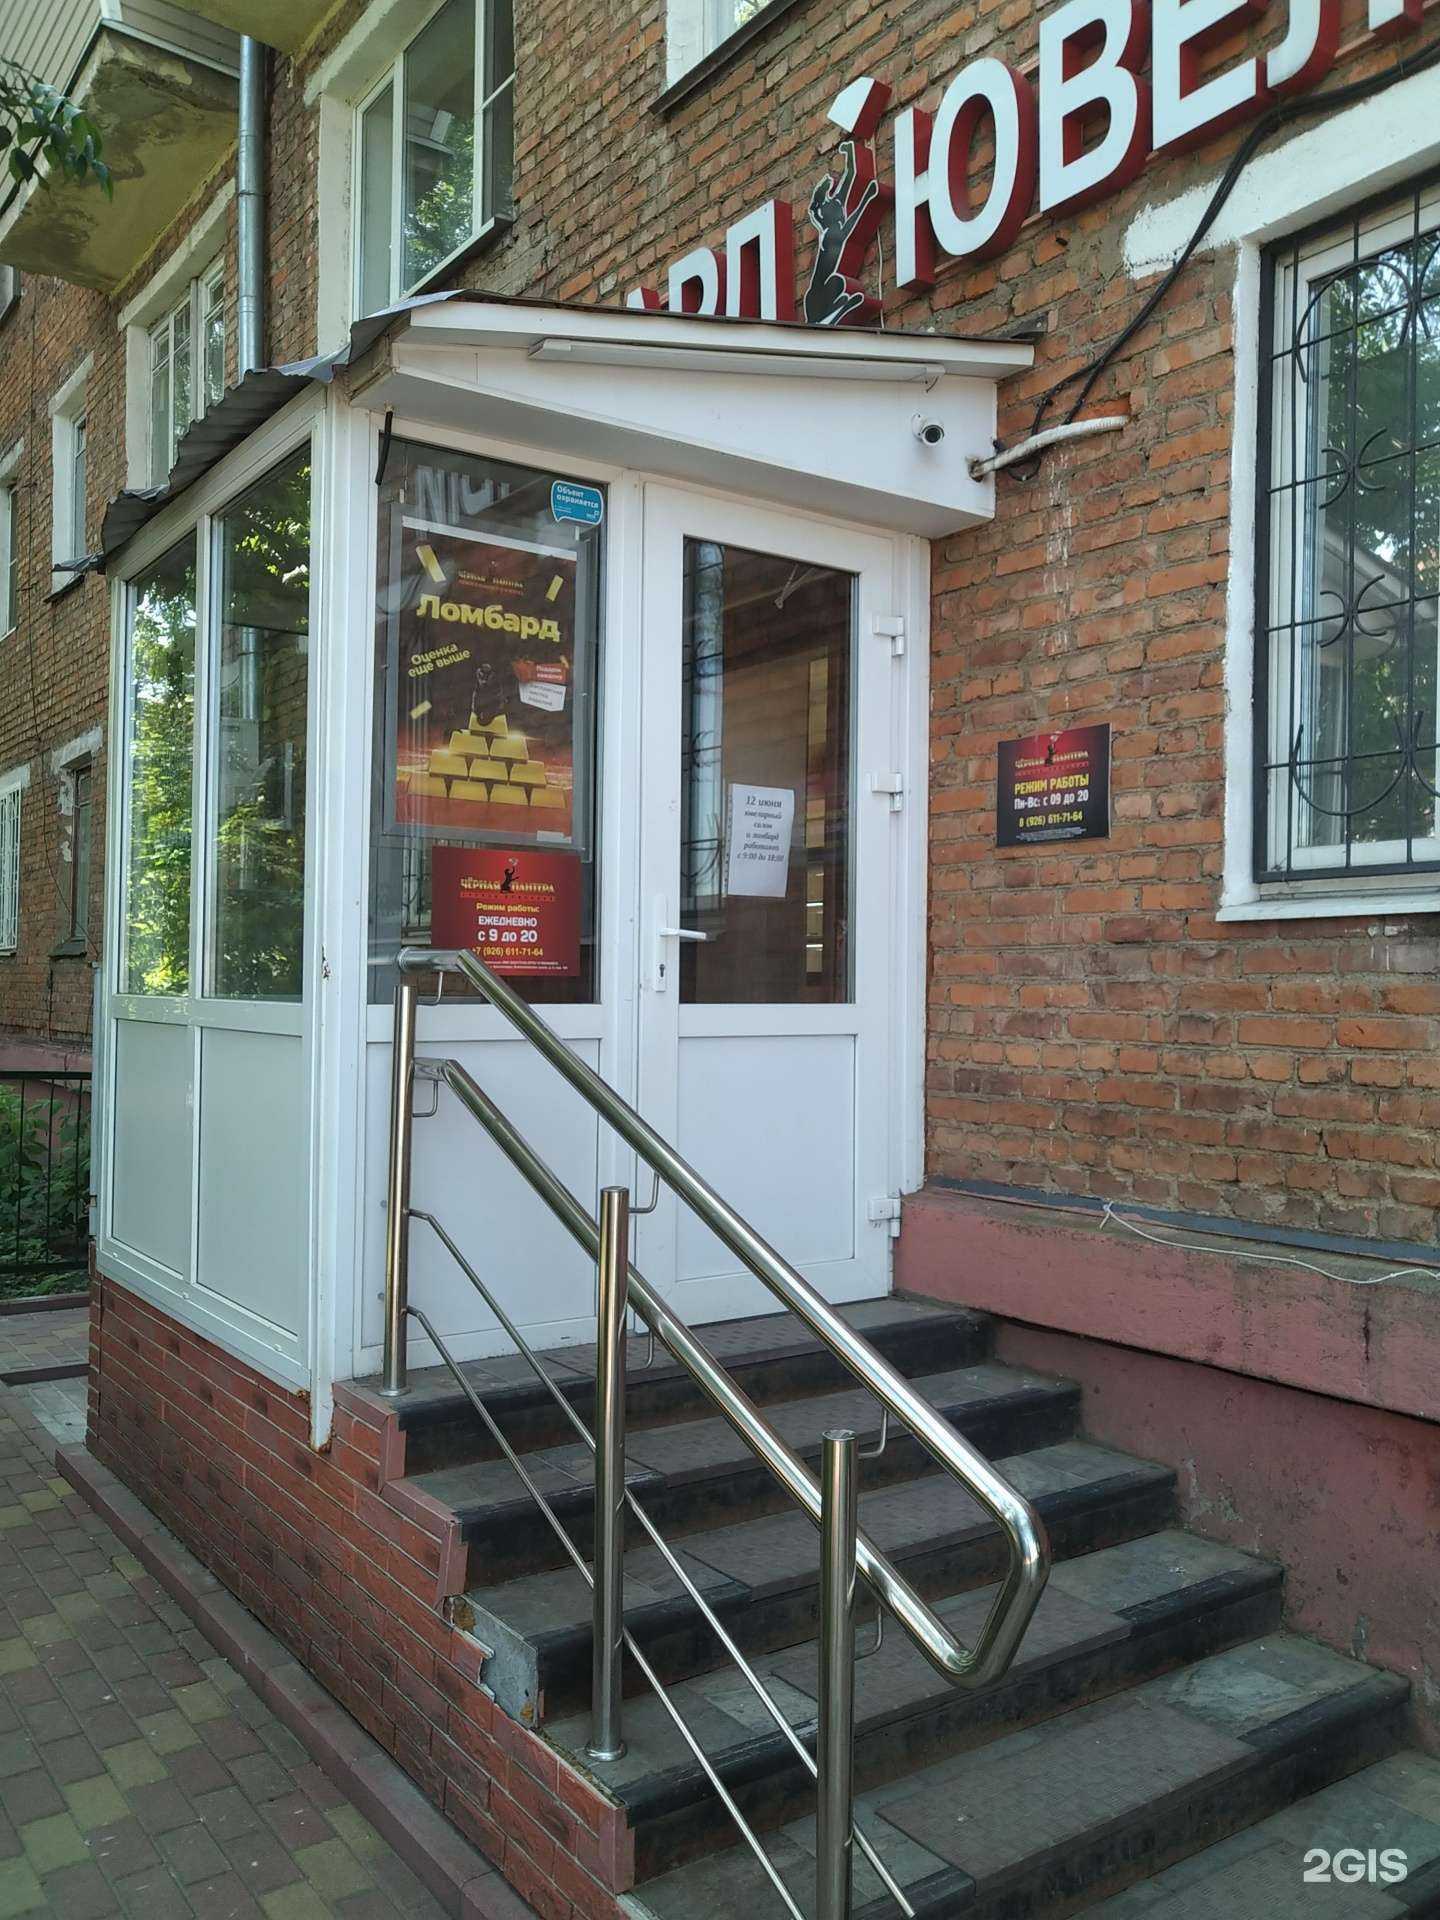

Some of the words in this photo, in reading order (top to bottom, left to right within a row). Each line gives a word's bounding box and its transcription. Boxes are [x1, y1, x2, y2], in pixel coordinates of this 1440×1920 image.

[416, 593, 561, 643] Ломбард
[411, 643, 458, 665] Оценка
[435, 650, 471, 668] выше
[1014, 780, 1047, 795] РЕЖИМ
[1050, 773, 1089, 790] РАБОТЫ
[746, 795, 756, 805] 12
[1014, 796, 1040, 810] Пн-Вс:
[1043, 796, 1048, 806] с
[1050, 793, 1061, 805] 09
[1063, 794, 1075, 806] до
[1077, 789, 1089, 801] 20
[1048, 811, 1083, 824] 611-71-64
[460, 877, 501, 890] ЧЁРНАЯ
[476, 902, 506, 911] Режим
[478, 915, 538, 927] ЕЖЕДНЕВНО
[478, 930, 486, 941] с
[488, 928, 498, 941] 9
[501, 931, 517, 942] до
[520, 929, 538, 942] 20
[505, 947, 544, 957] 611-71-64
